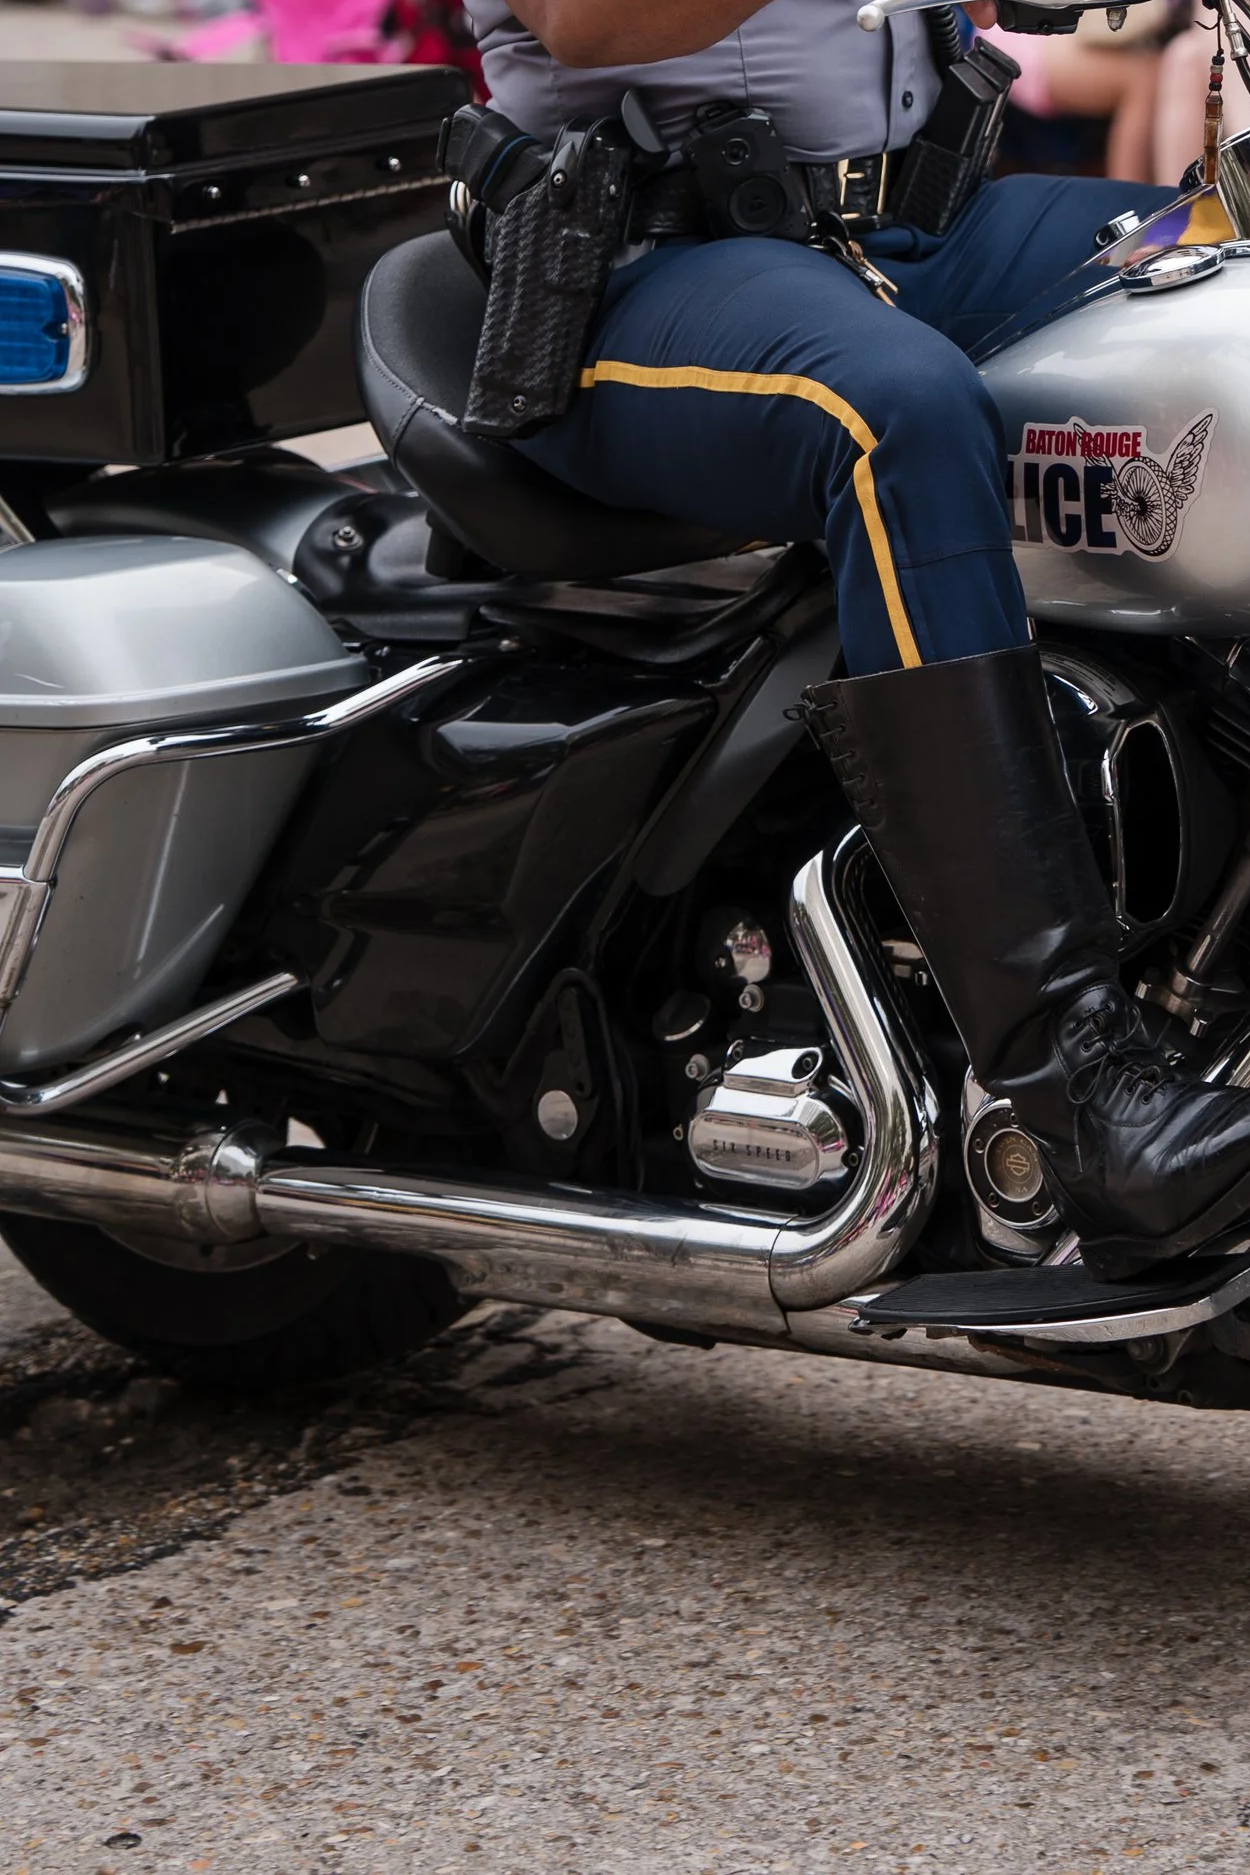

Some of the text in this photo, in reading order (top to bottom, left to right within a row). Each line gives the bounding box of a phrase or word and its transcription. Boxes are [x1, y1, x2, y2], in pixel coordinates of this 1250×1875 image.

[1026, 429, 1142, 458] BATON ROUGE
[713, 1139, 791, 1162] SIX SPEED
